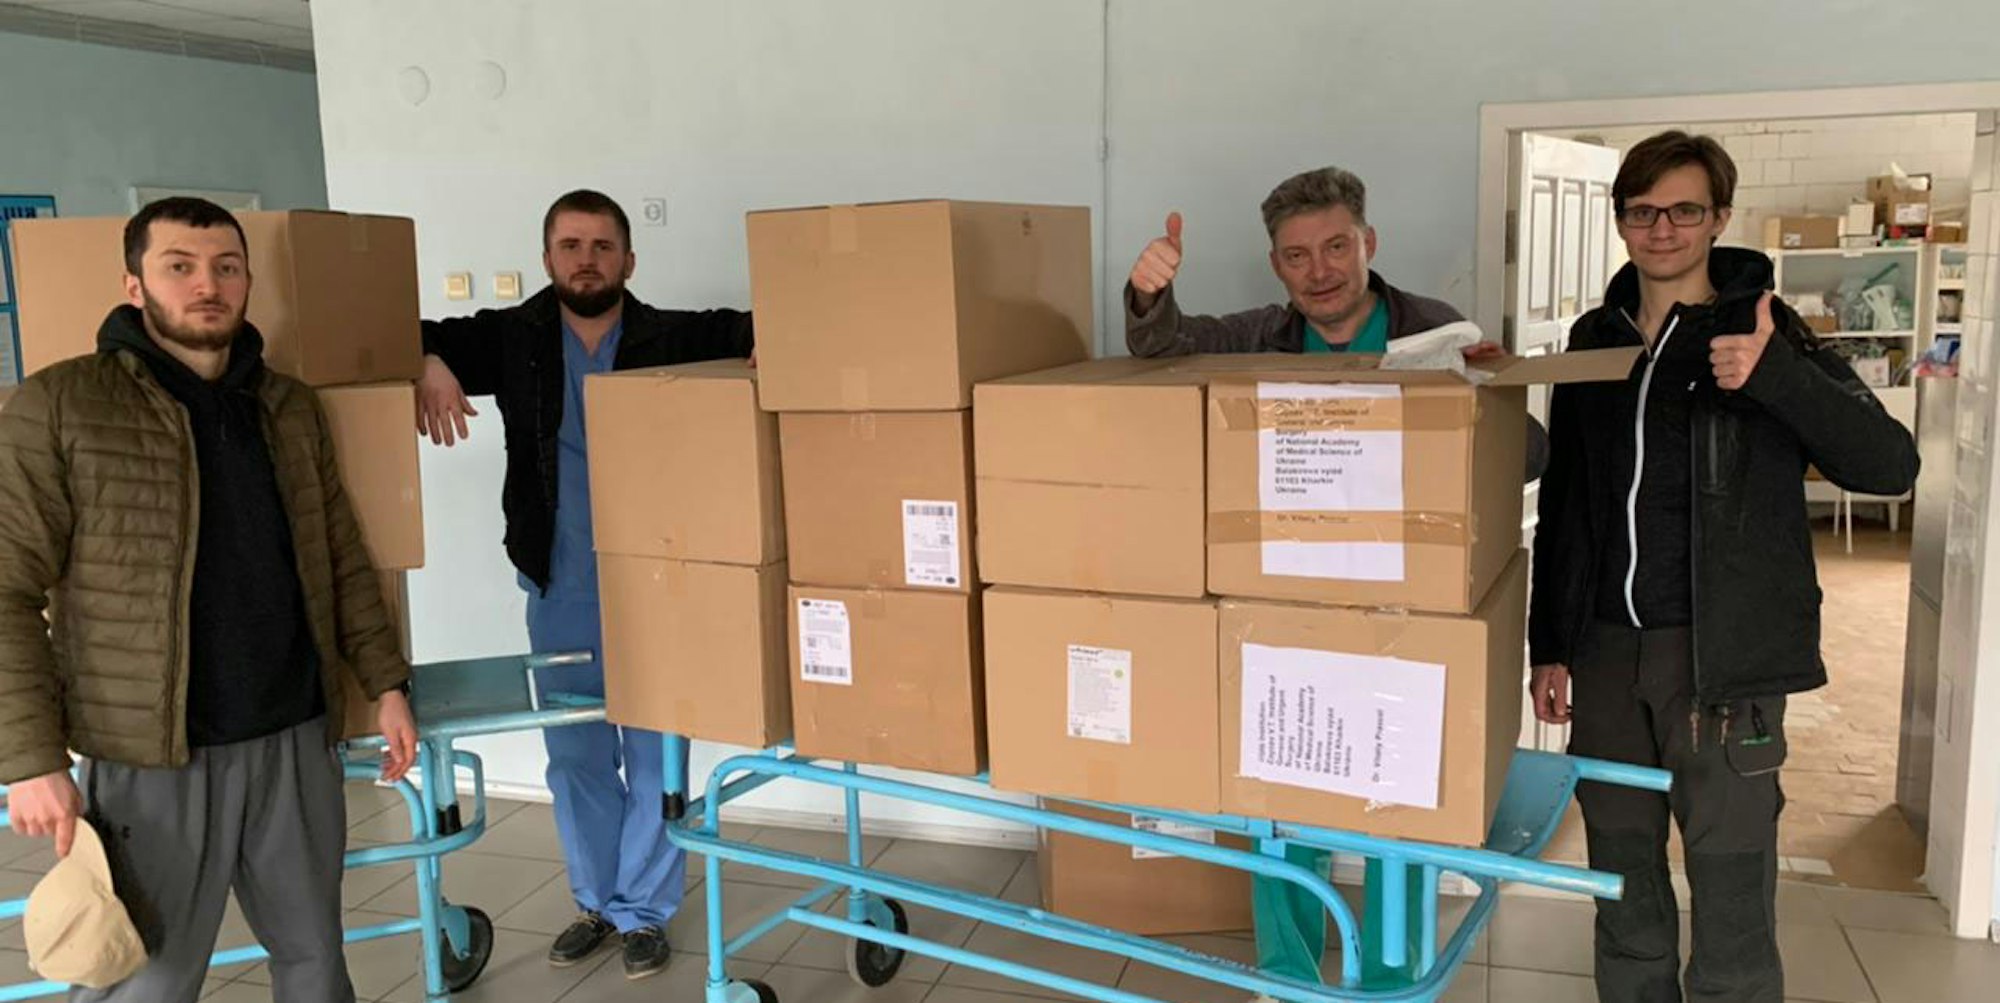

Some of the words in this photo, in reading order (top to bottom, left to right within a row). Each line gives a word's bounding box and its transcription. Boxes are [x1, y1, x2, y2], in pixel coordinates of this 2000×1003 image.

[1275, 428, 1307, 437] Surgery
[1286, 437, 1319, 445] National
[1321, 438, 1360, 447] Academy
[1286, 447, 1317, 455] Medical
[1319, 448, 1351, 456] Science
[1275, 457, 1306, 465] Ukraine
[1275, 486, 1307, 494] Ukraine
[1269, 674, 1276, 684] of
[1307, 685, 1315, 695] of
[1278, 690, 1287, 717] Urgent
[1297, 688, 1307, 723] Academy
[1306, 697, 1315, 727] Science
[1275, 735, 1284, 767] General
[1296, 725, 1304, 759] National
[1305, 728, 1314, 760] Medical
[1285, 735, 1296, 768] Surgery
[1314, 741, 1323, 773] Ukraine
[1295, 760, 1302, 769] of
[1304, 761, 1311, 771] of
[1343, 746, 1351, 777] Ukraine
